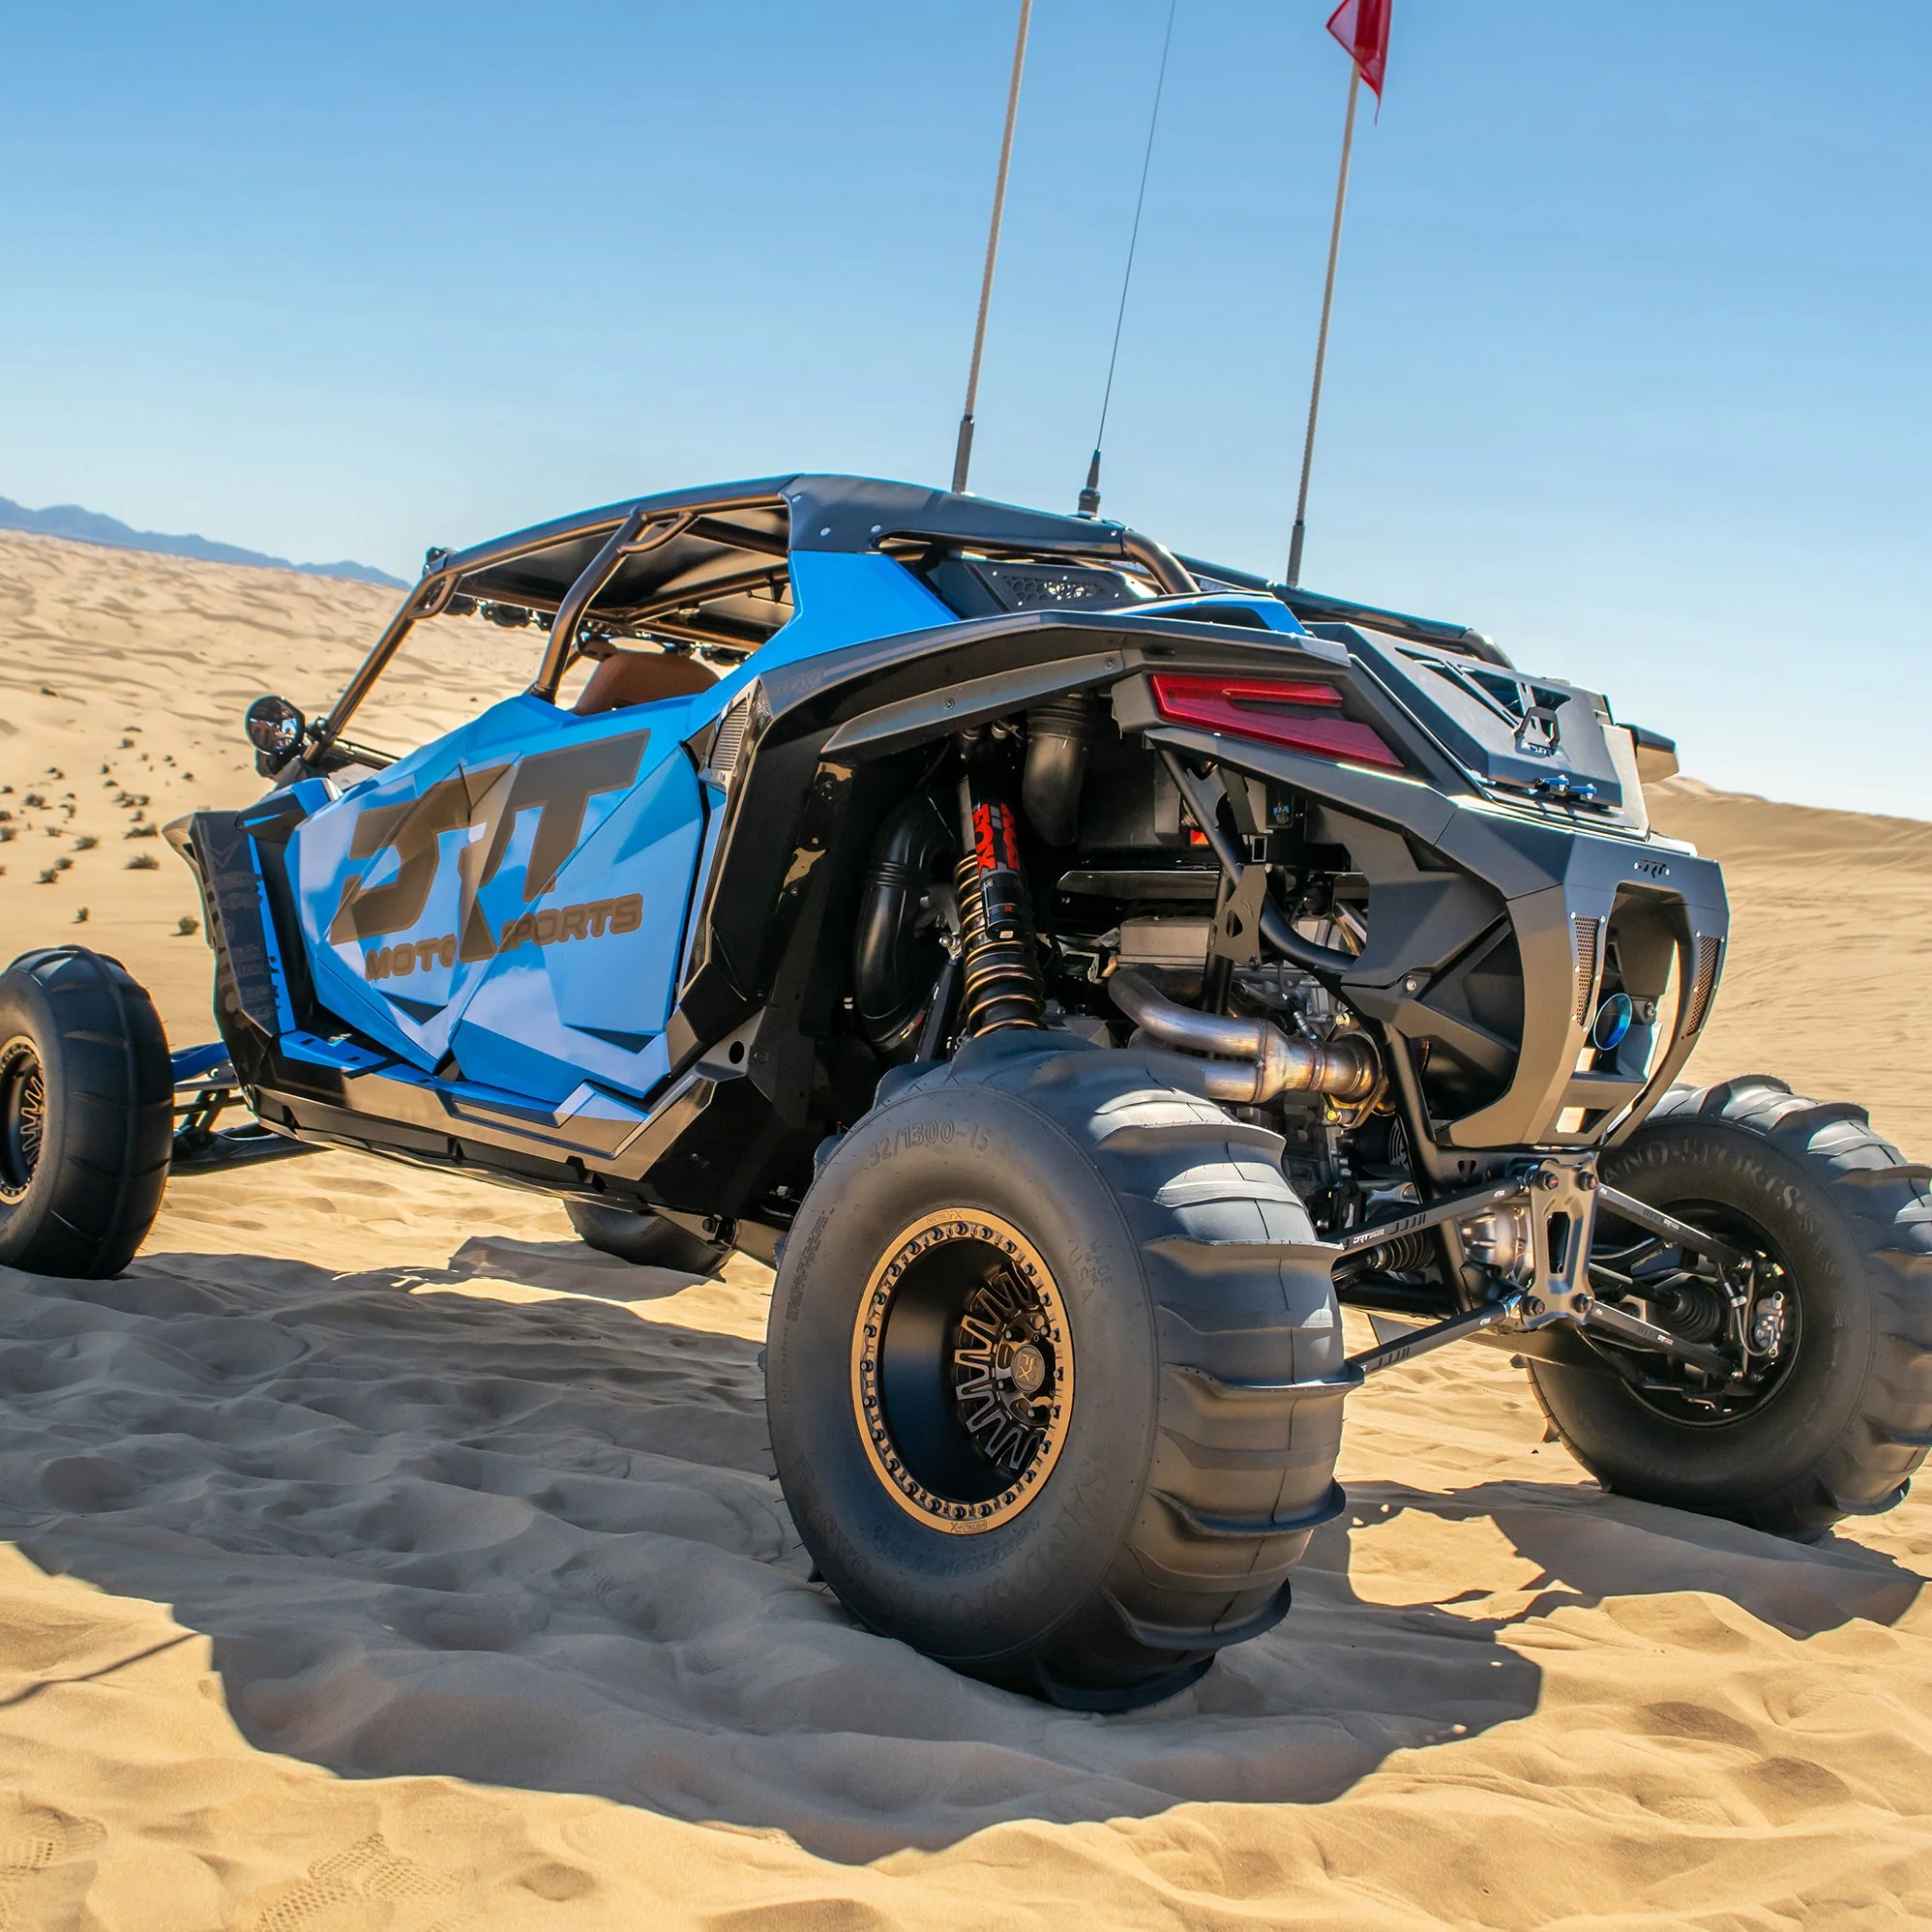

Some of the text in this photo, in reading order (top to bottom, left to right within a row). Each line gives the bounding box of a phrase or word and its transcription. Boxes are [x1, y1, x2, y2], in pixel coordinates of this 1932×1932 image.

[972, 803, 996, 873] FOX
[867, 1118, 992, 1168] 32/1300-15
[949, 1208, 964, 1221] FX
[1070, 1244, 1094, 1303] USA
